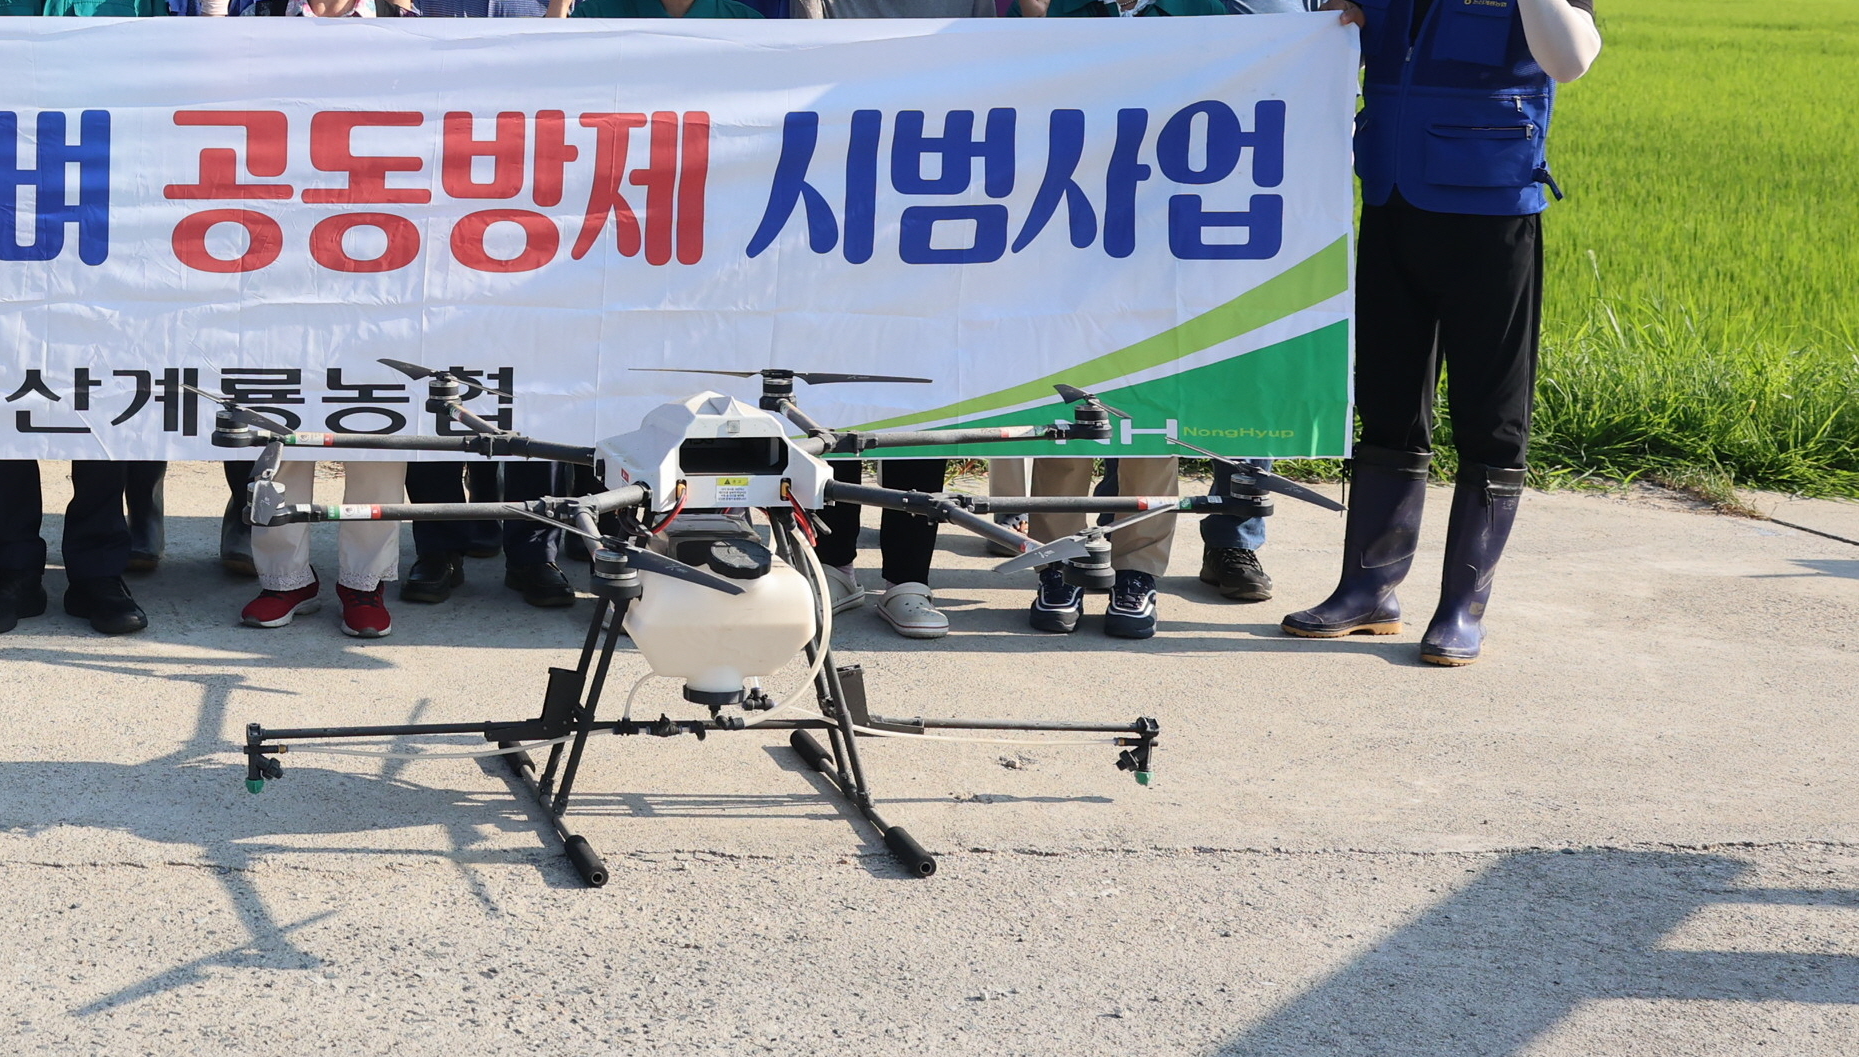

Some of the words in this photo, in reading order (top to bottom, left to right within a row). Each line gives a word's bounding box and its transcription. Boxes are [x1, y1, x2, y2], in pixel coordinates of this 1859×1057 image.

[163, 109, 710, 273] 공동방제
[745, 99, 1286, 265] 시범사업
[1182, 426, 1295, 439] NongHyup
